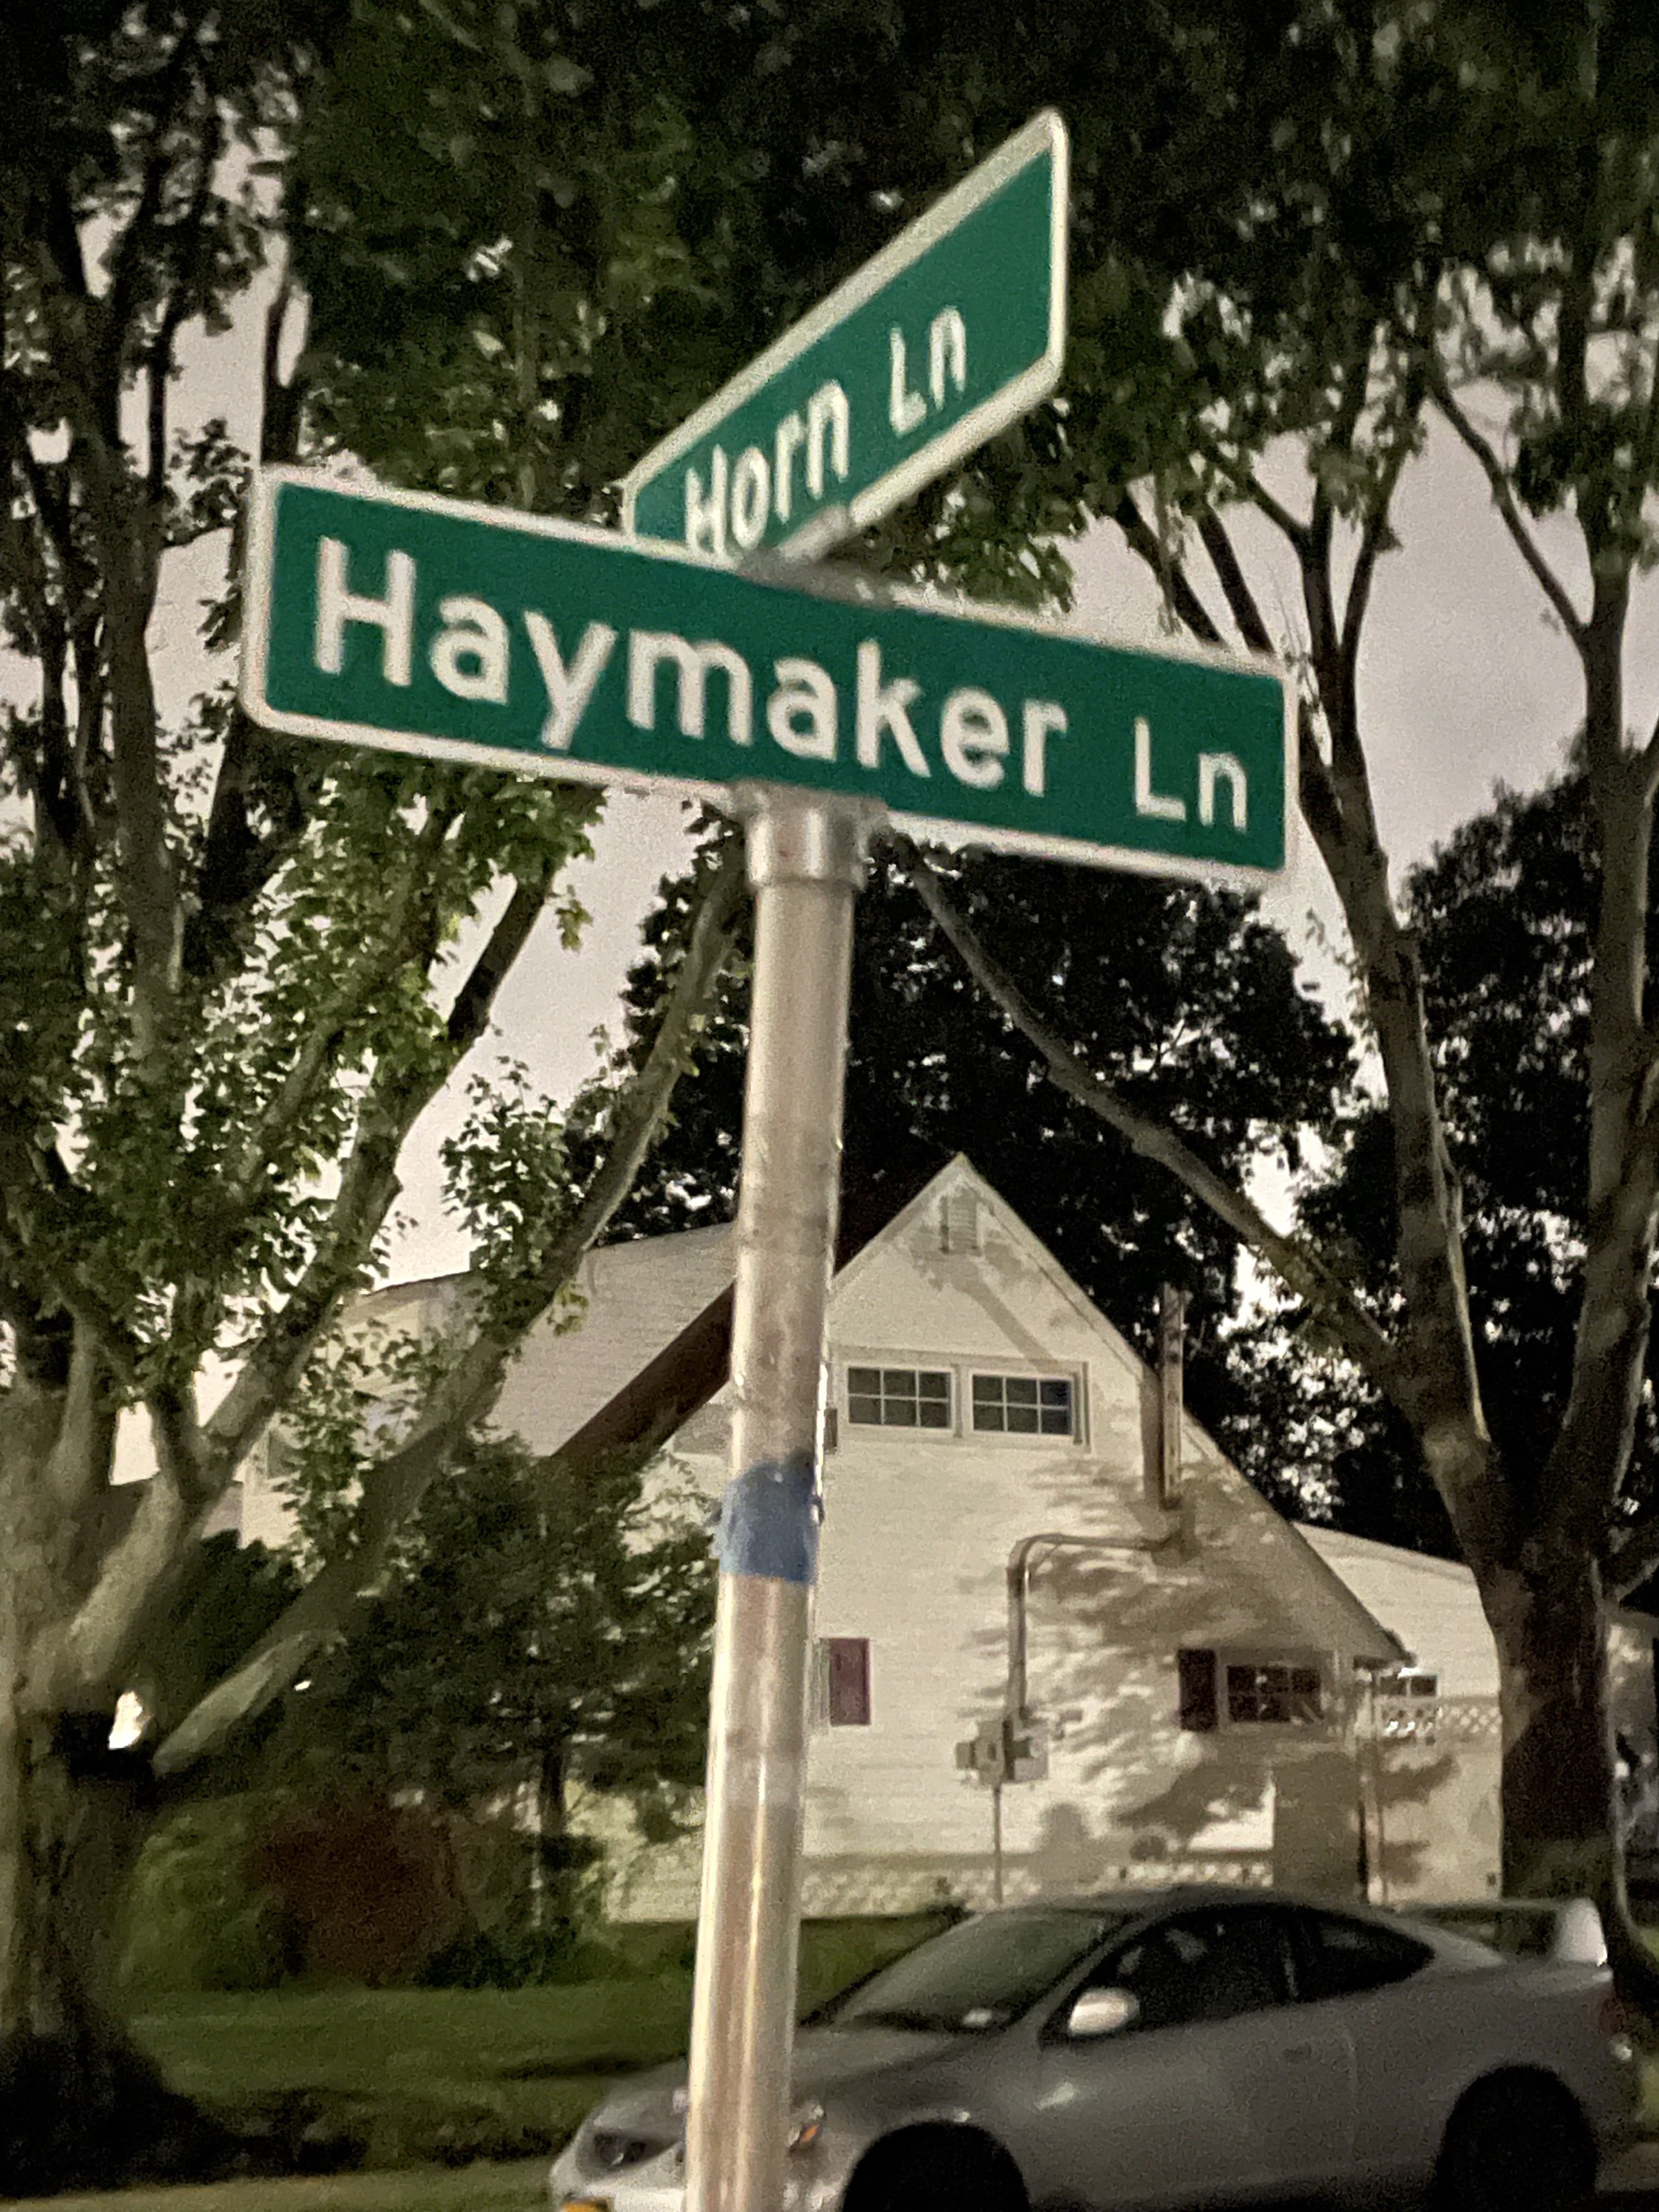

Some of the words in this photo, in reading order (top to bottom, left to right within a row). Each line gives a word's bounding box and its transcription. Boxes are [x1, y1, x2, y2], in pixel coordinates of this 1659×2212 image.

[685, 378, 850, 556] Horn
[888, 305, 967, 438] Ln
[313, 535, 1068, 798] Haymaker
[1134, 717, 1248, 830] Ln
